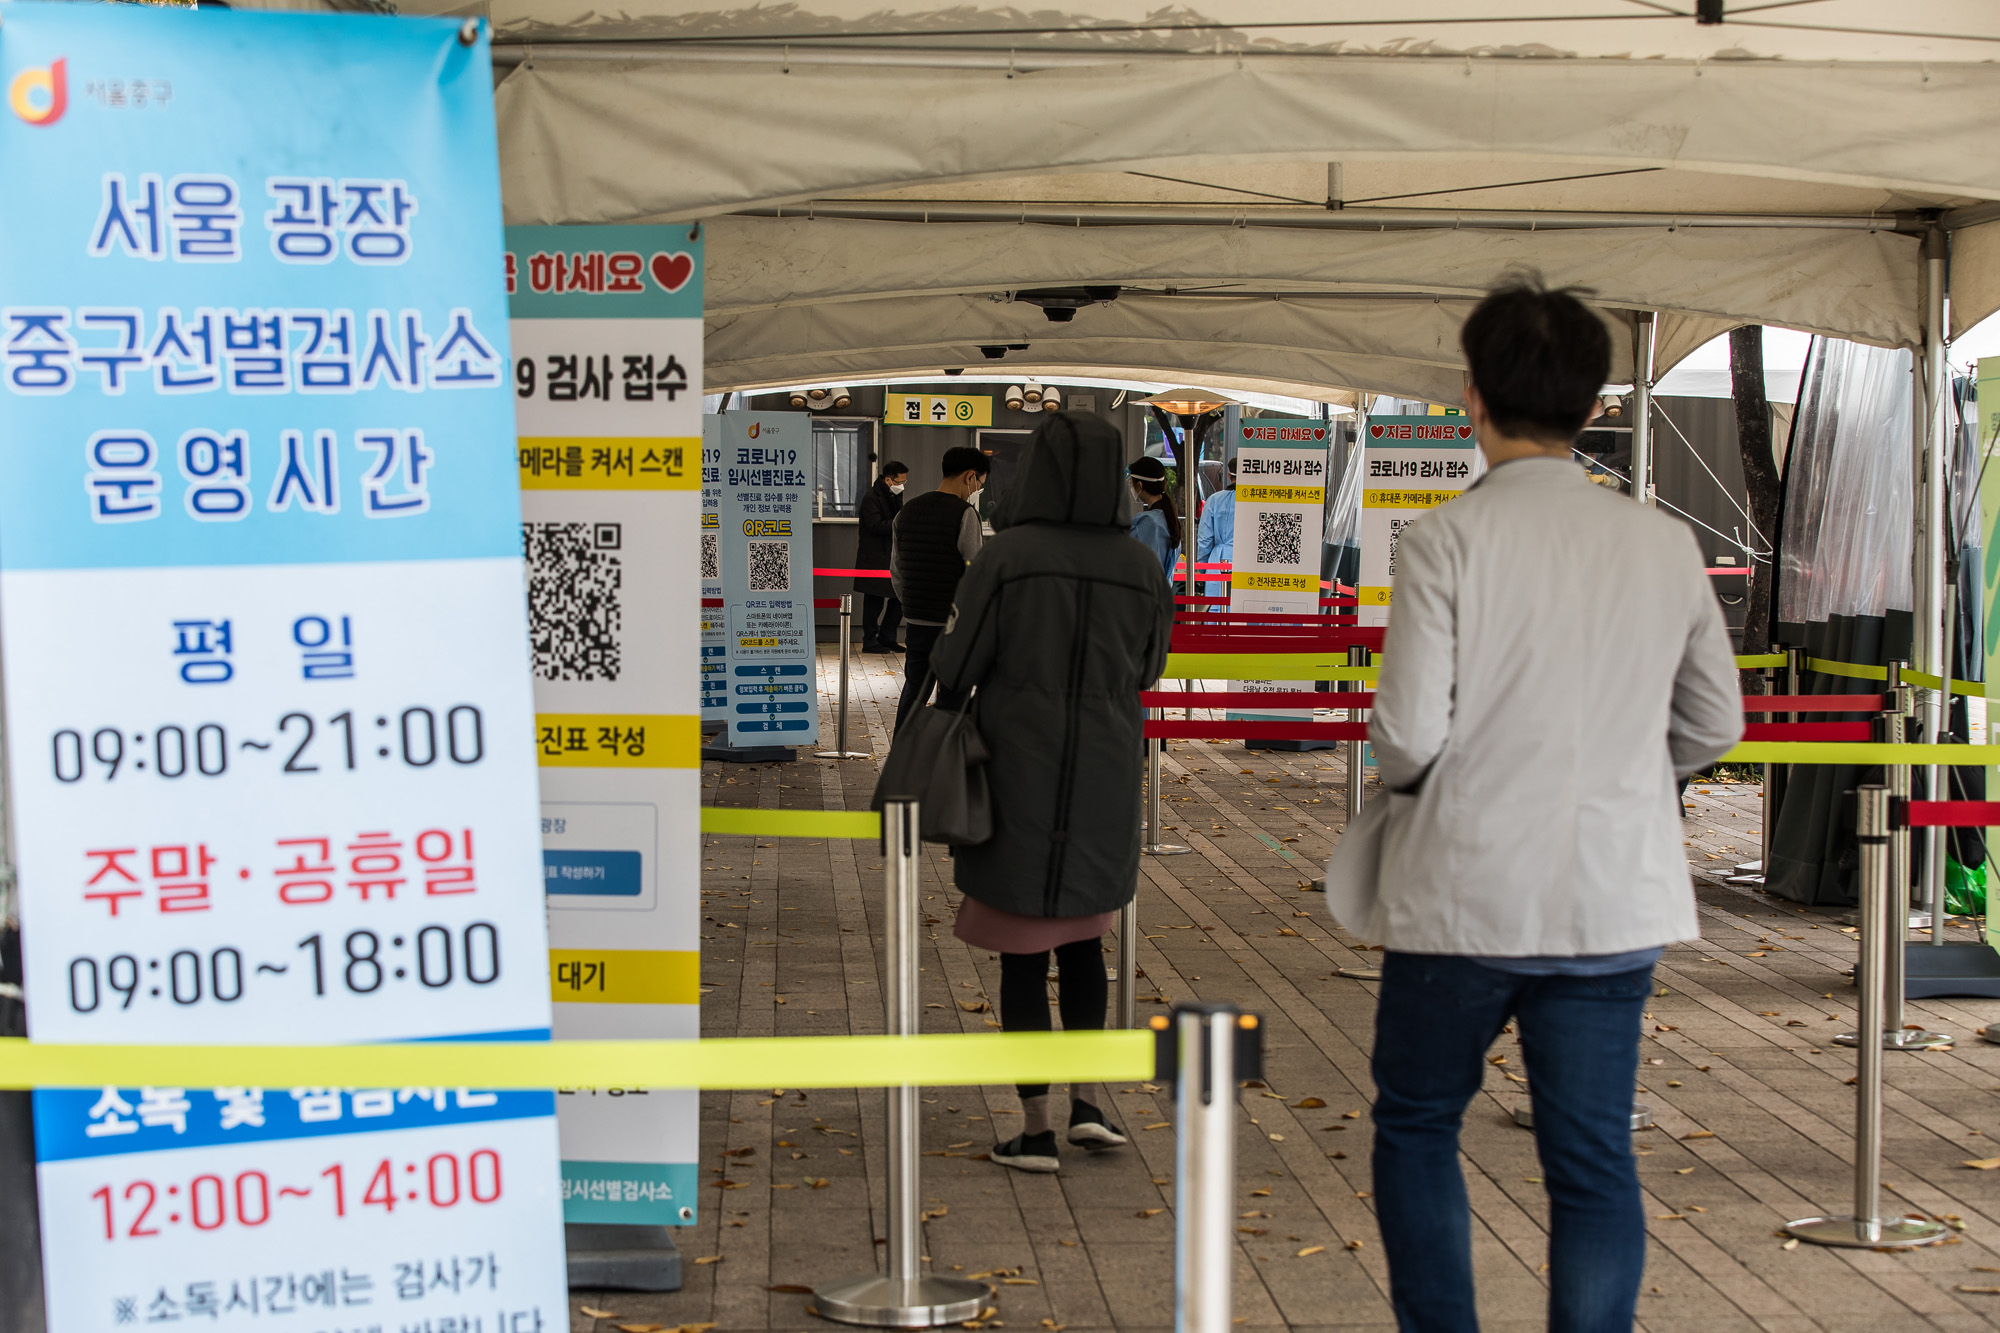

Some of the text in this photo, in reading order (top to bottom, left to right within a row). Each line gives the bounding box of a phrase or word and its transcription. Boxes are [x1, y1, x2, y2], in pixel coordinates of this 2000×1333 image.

[90, 174, 415, 264] 서울 광장
[529, 252, 643, 293] 하세요
[3, 308, 500, 393] 중구선별검사소
[547, 354, 613, 402] 검사
[623, 354, 688, 402] 접수
[1255, 427, 1312, 441] 지금 하세요
[1386, 424, 1455, 440] 지금 하세요
[515, 446, 683, 477] 메라를 켜서 스캔
[737, 448, 797, 465] 코로나19
[702, 467, 722, 483] 진료
[1242, 459, 1322, 476] 코로나19 검사 접수
[1370, 460, 1469, 478] 코로나19 검사 접수
[728, 468, 806, 487] 임시선별진료소
[736, 492, 798, 502] 선별진료 접수를 위한
[1250, 488, 1268, 498] 휴대폰
[1269, 488, 1293, 499] 카메라를
[1294, 489, 1307, 499] 켜서
[1308, 489, 1320, 500] 스캔
[1379, 492, 1401, 504] 휴대폰
[1402, 493, 1432, 505] 카메라를
[1433, 493, 1449, 504] 켜서
[742, 503, 792, 513] 개인 정보 입력용
[743, 519, 792, 537] QR코드
[1256, 576, 1290, 588] 전자문진표
[1292, 578, 1306, 588] 작성
[746, 600, 792, 609] QR코드 입력방법
[50, 704, 487, 785] 09:00~21:00
[536, 726, 645, 757] 진표 작성
[66, 921, 502, 1014] 09:00~18:00
[557, 961, 605, 991] 대기
[91, 1148, 502, 1242] 12:00~14:00
[393, 1253, 500, 1301] 검사가
